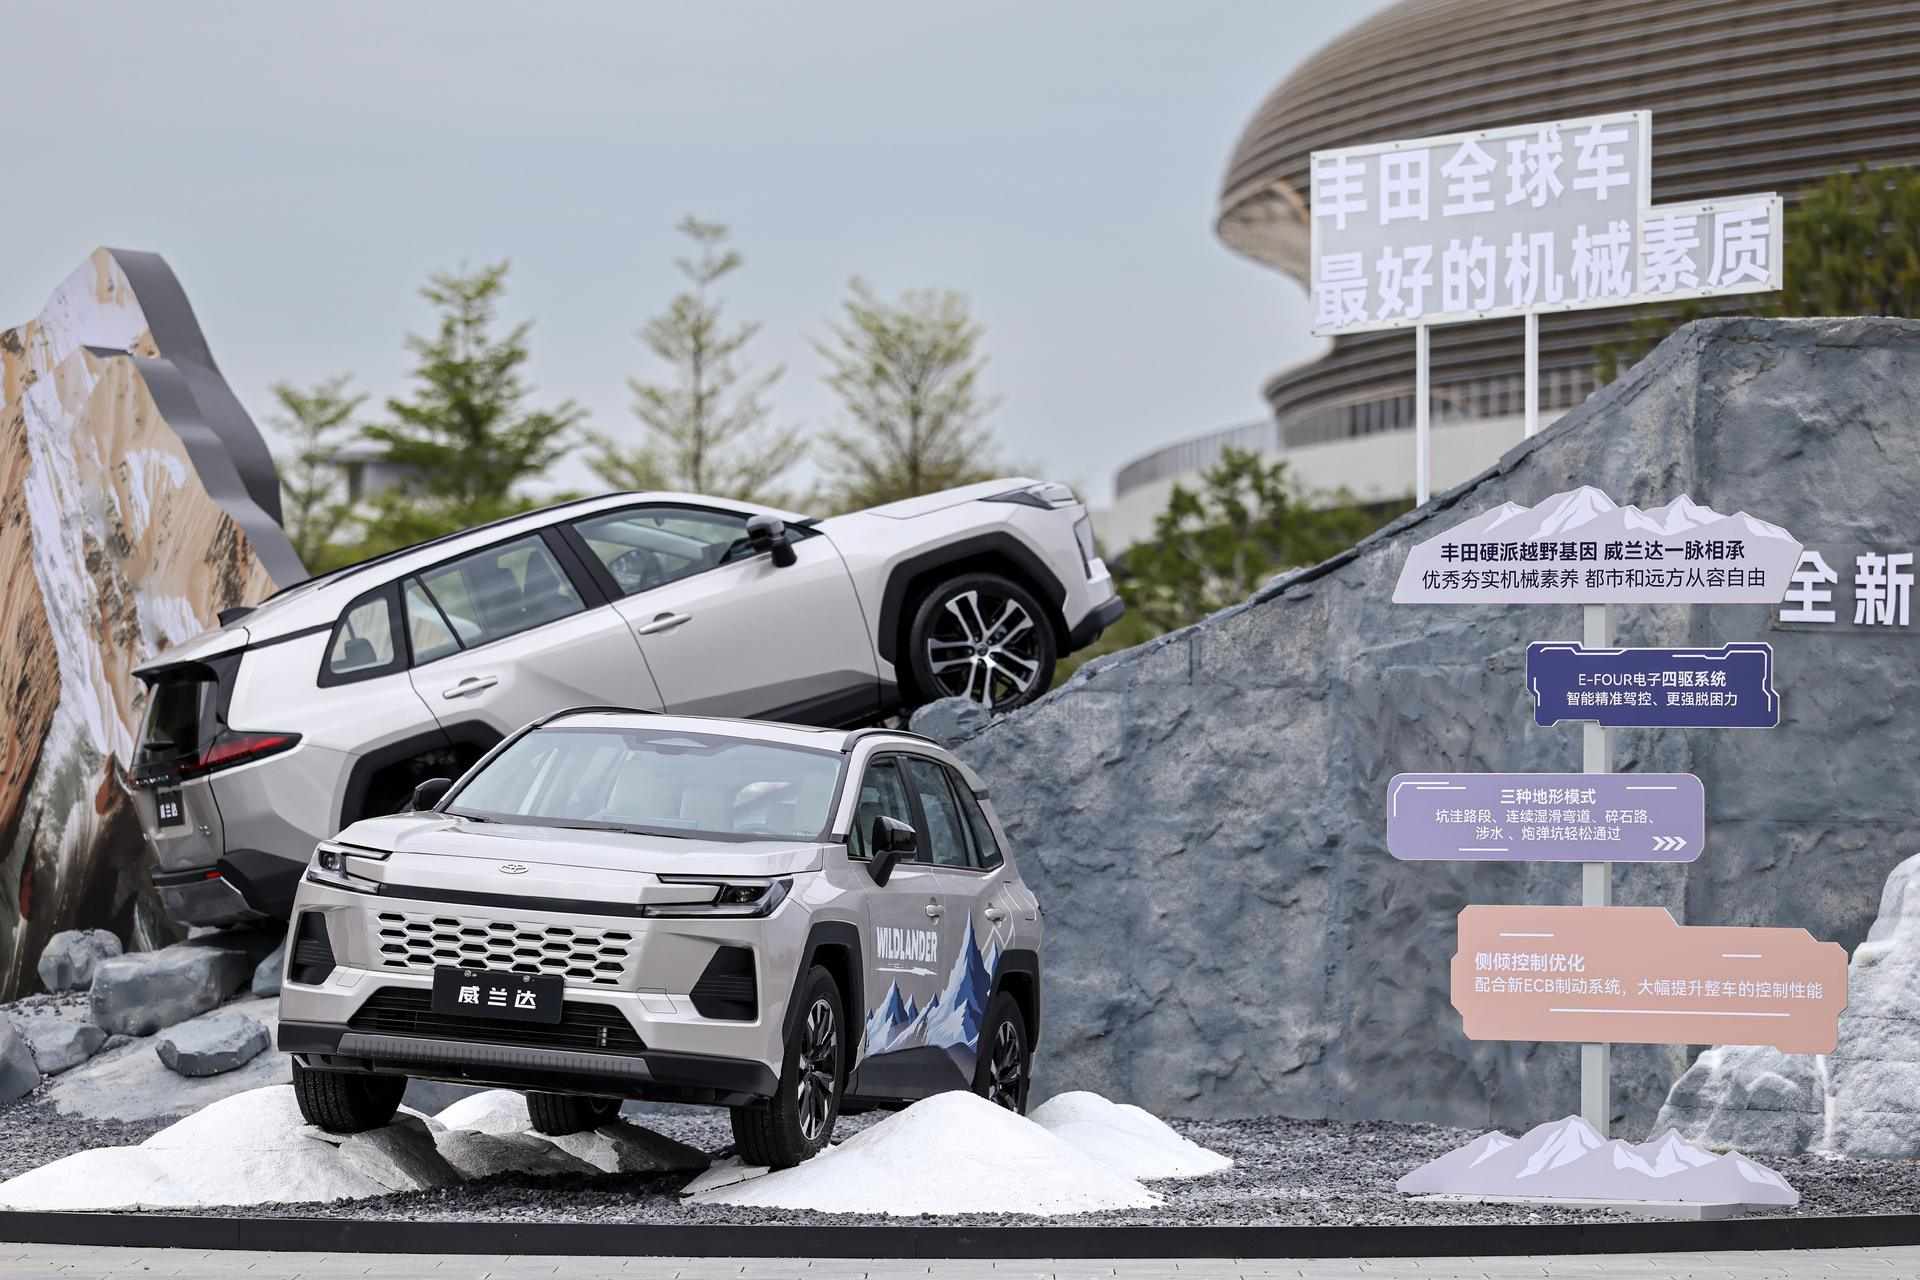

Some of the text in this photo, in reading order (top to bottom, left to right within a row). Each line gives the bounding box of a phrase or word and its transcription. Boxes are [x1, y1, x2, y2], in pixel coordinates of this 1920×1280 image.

[1314, 125, 1632, 230] 丰田全球车
[1314, 206, 1773, 327] 最好的机械素质
[1440, 540, 1745, 562] 丰田硬派越野基因 威兰达一脉相承
[1422, 568, 1766, 590] 优秀夯实机械素养 都市和远方从容自由
[1779, 551, 1914, 626] 全新
[1578, 671, 1727, 687] E-FOUR电子四驱系统
[1566, 692, 1738, 707] 智能精准驾控、更强脱困力
[1500, 788, 1597, 805] 三种地形模式
[876, 927, 938, 962] WILDLANDER
[1474, 952, 1585, 972] 侧倾控制优化
[458, 985, 537, 1010] 威兰达
